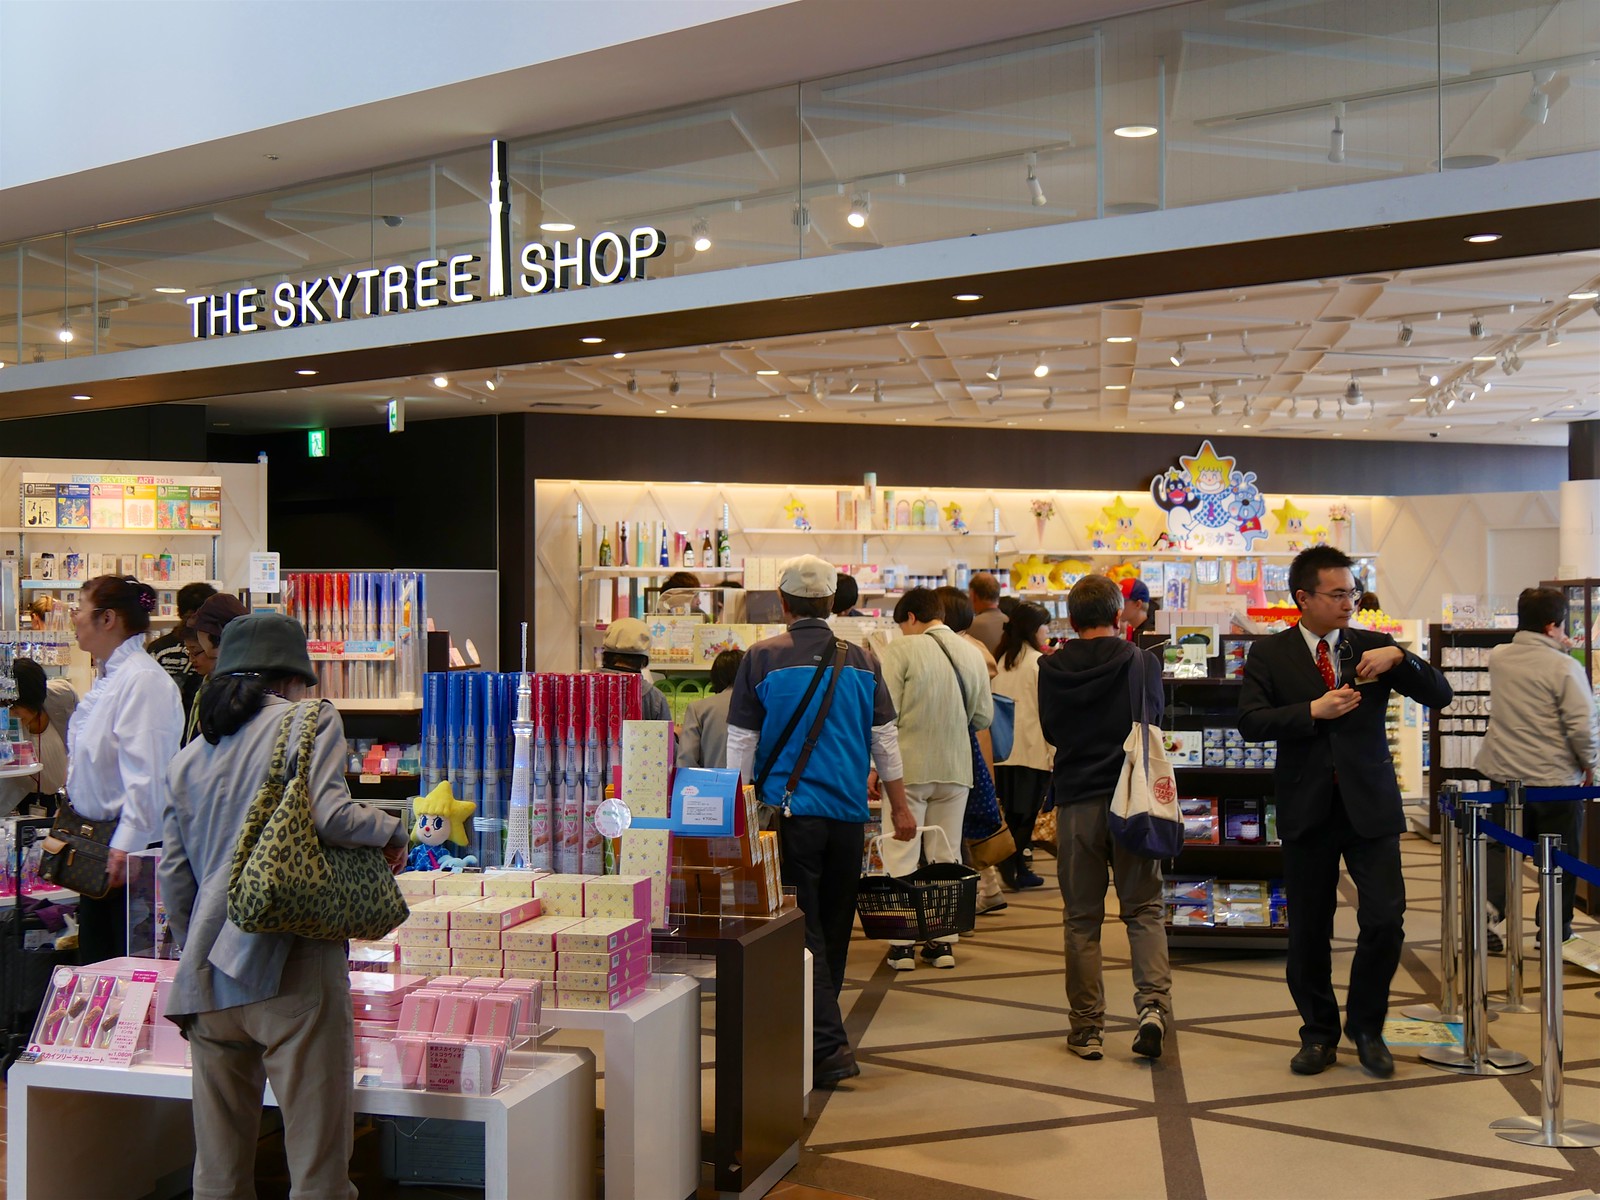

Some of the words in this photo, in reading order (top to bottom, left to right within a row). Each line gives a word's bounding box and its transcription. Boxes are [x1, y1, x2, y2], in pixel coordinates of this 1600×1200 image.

[187, 287, 263, 338] THE
[273, 254, 479, 328] SKYTREE
[521, 226, 664, 294] SHOP
[73, 475, 100, 483] TOKYO
[101, 476, 136, 484] SKYTREE
